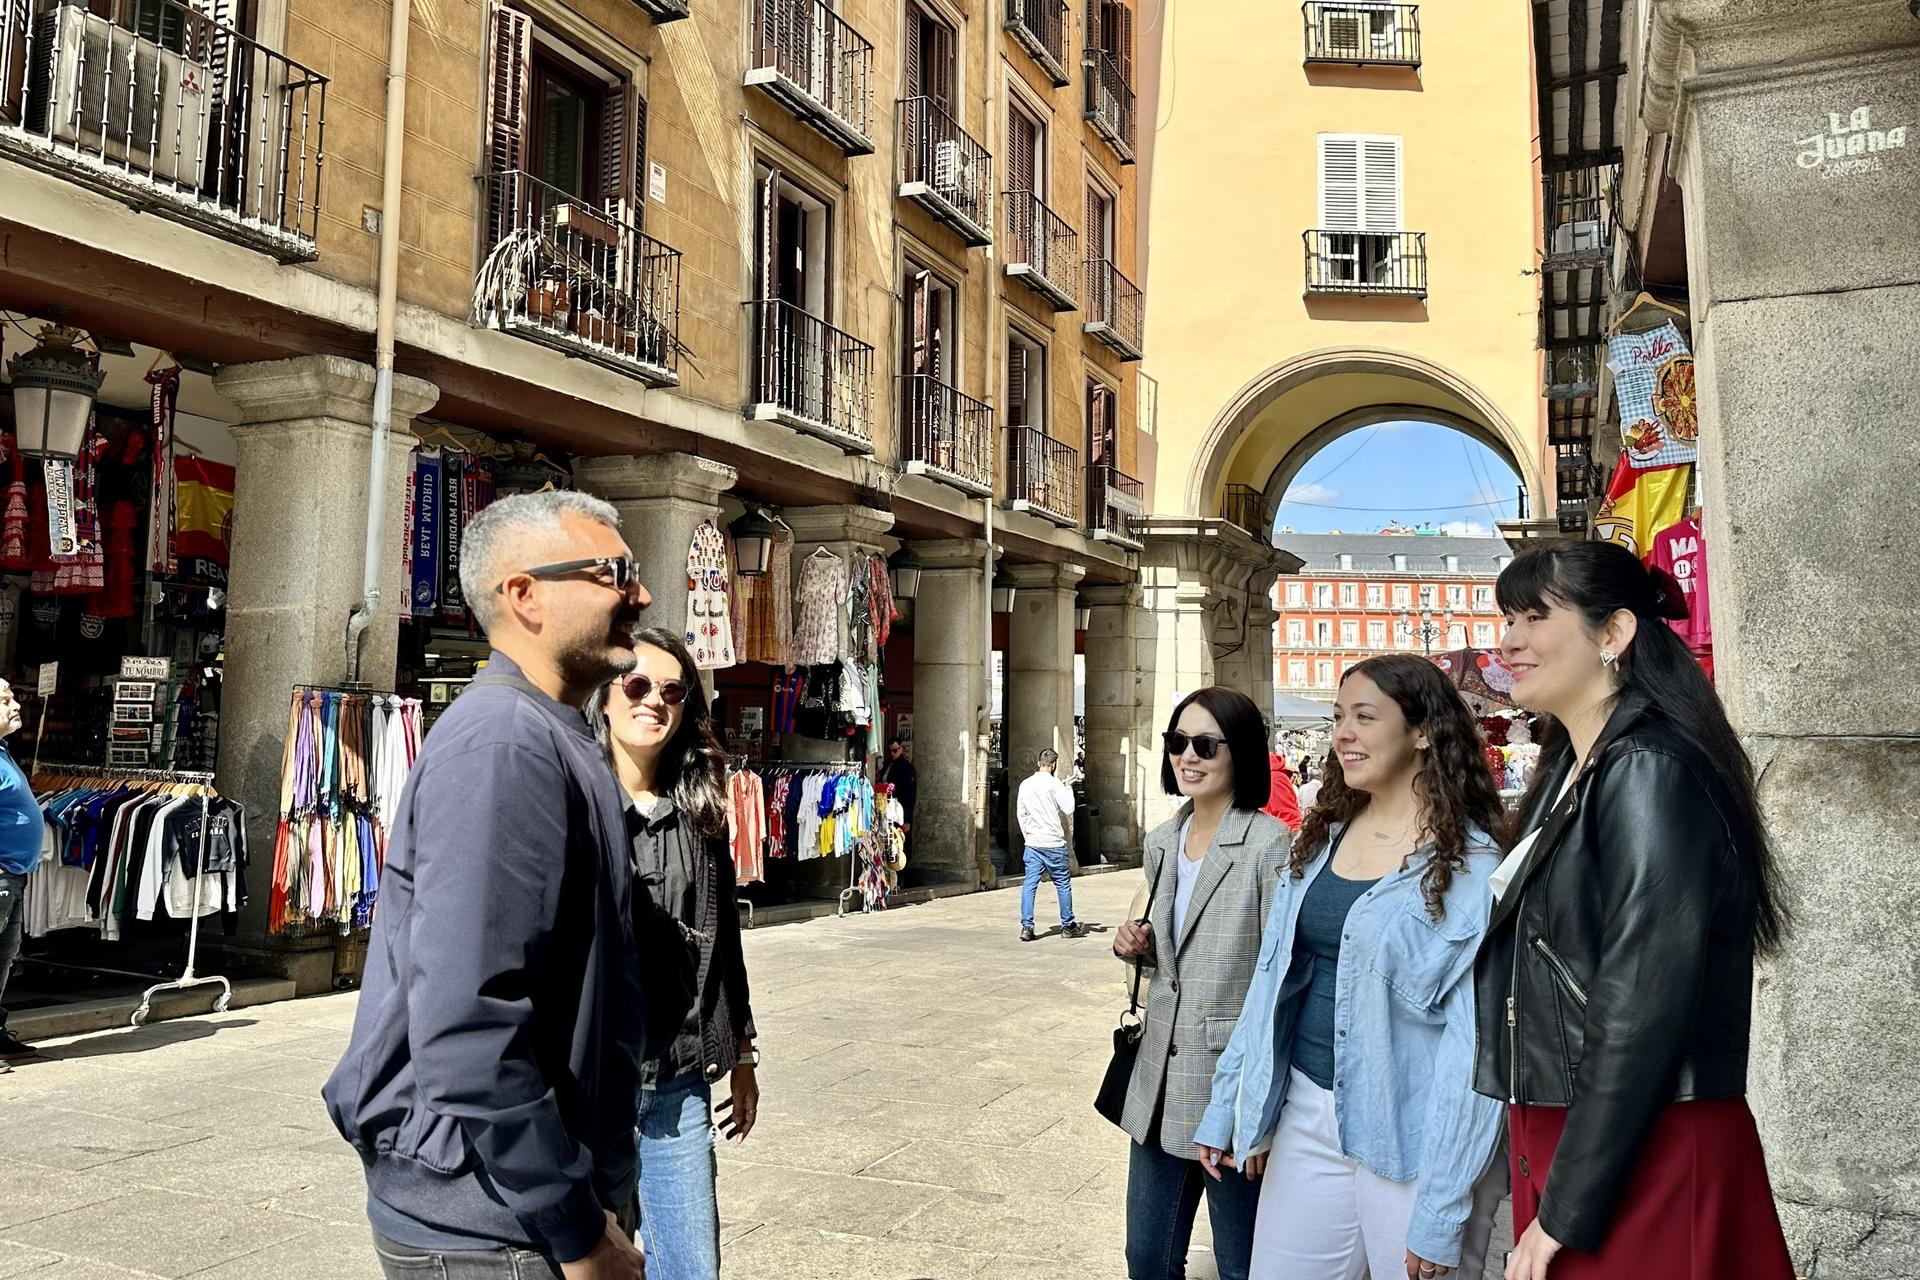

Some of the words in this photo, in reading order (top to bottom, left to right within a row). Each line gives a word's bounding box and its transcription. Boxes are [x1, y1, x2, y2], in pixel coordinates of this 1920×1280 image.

[55, 468, 68, 534] ARGENTINA
[195, 558, 229, 583] REA
[1678, 563, 1687, 575] 11
[125, 666, 134, 676] TU
[136, 667, 165, 677] NOMBRE
[191, 826, 224, 839] ESAÑA
